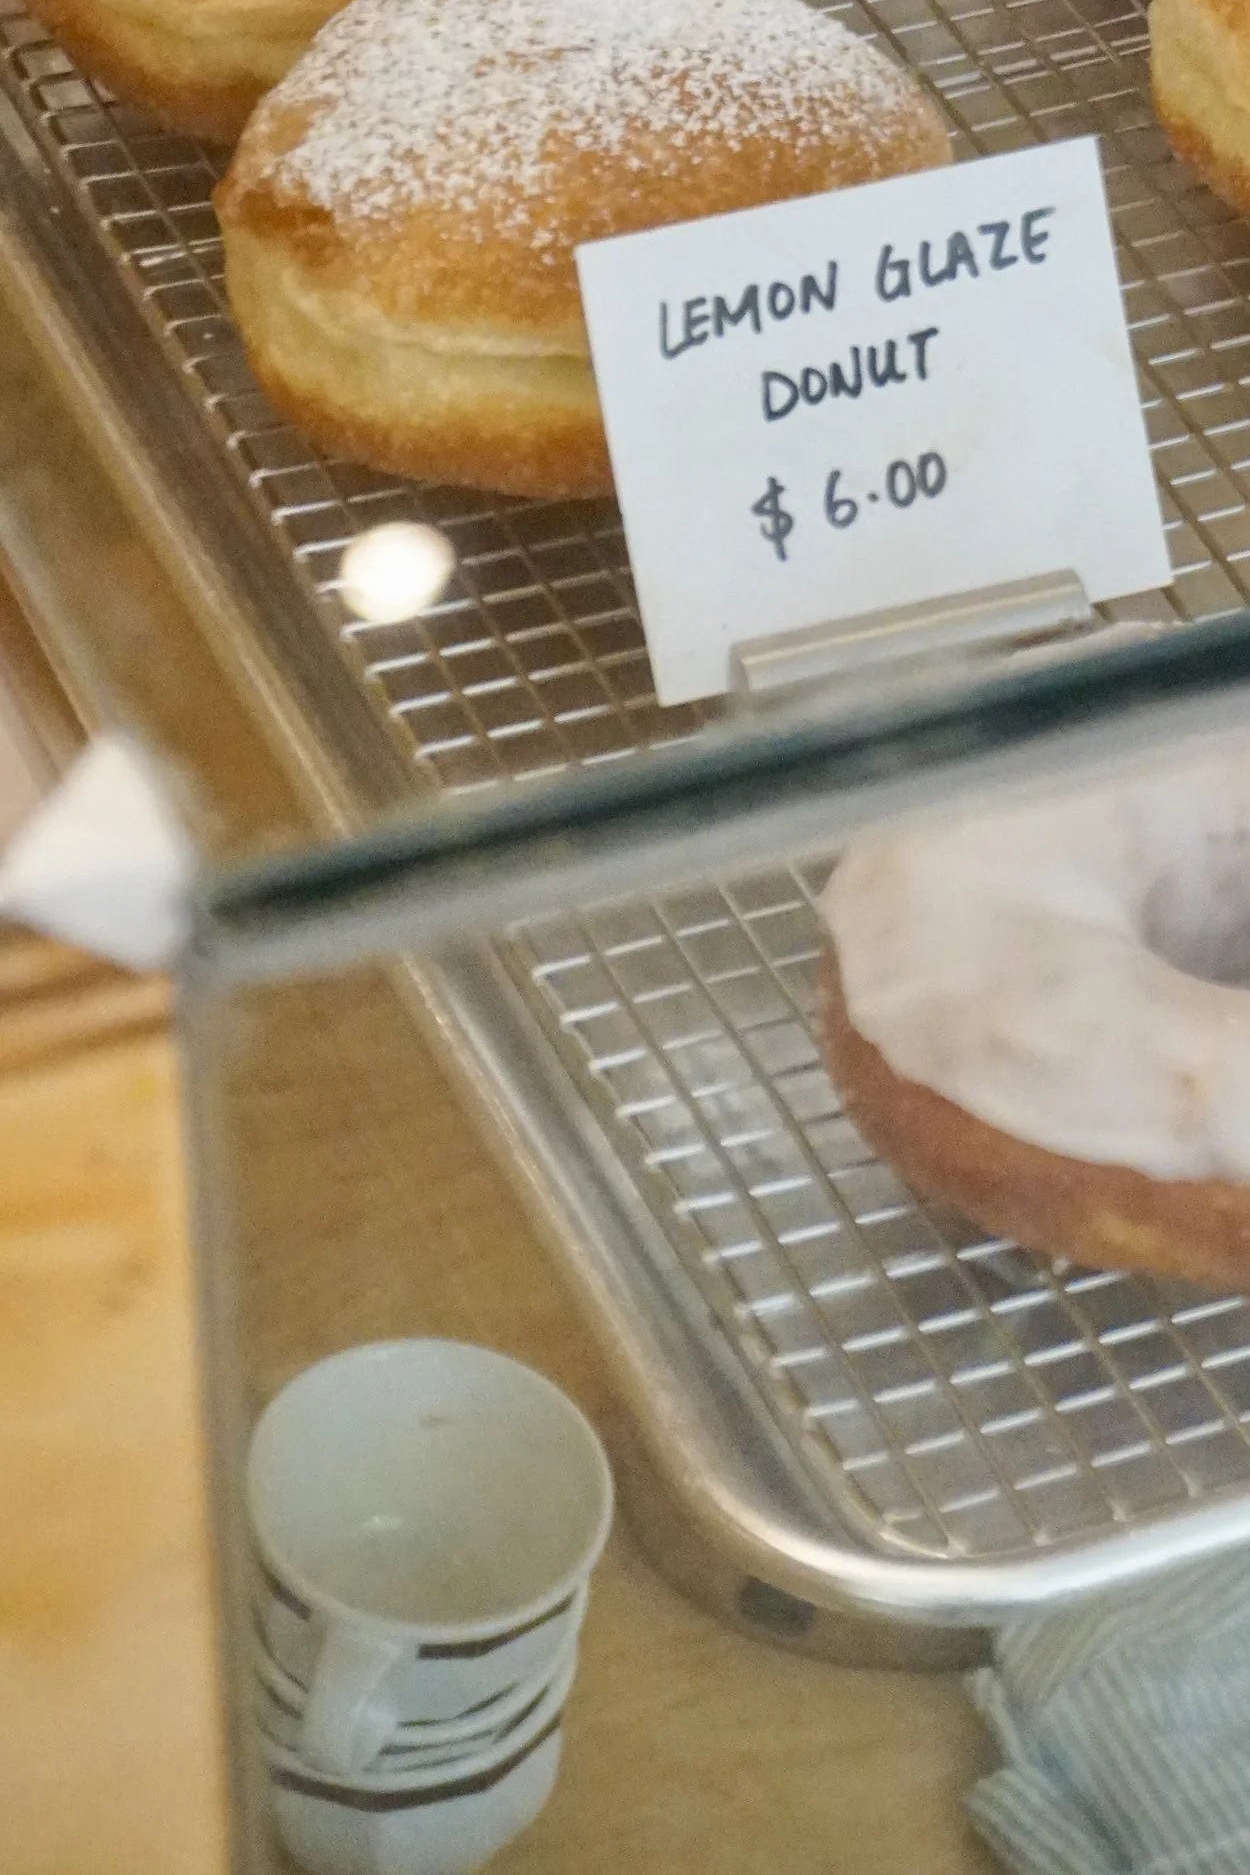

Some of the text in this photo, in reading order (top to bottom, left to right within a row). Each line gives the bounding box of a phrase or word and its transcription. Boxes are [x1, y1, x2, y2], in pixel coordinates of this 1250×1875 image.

[660, 207, 1055, 360] LEMON GLAZE
[761, 326, 940, 423] DONUT
